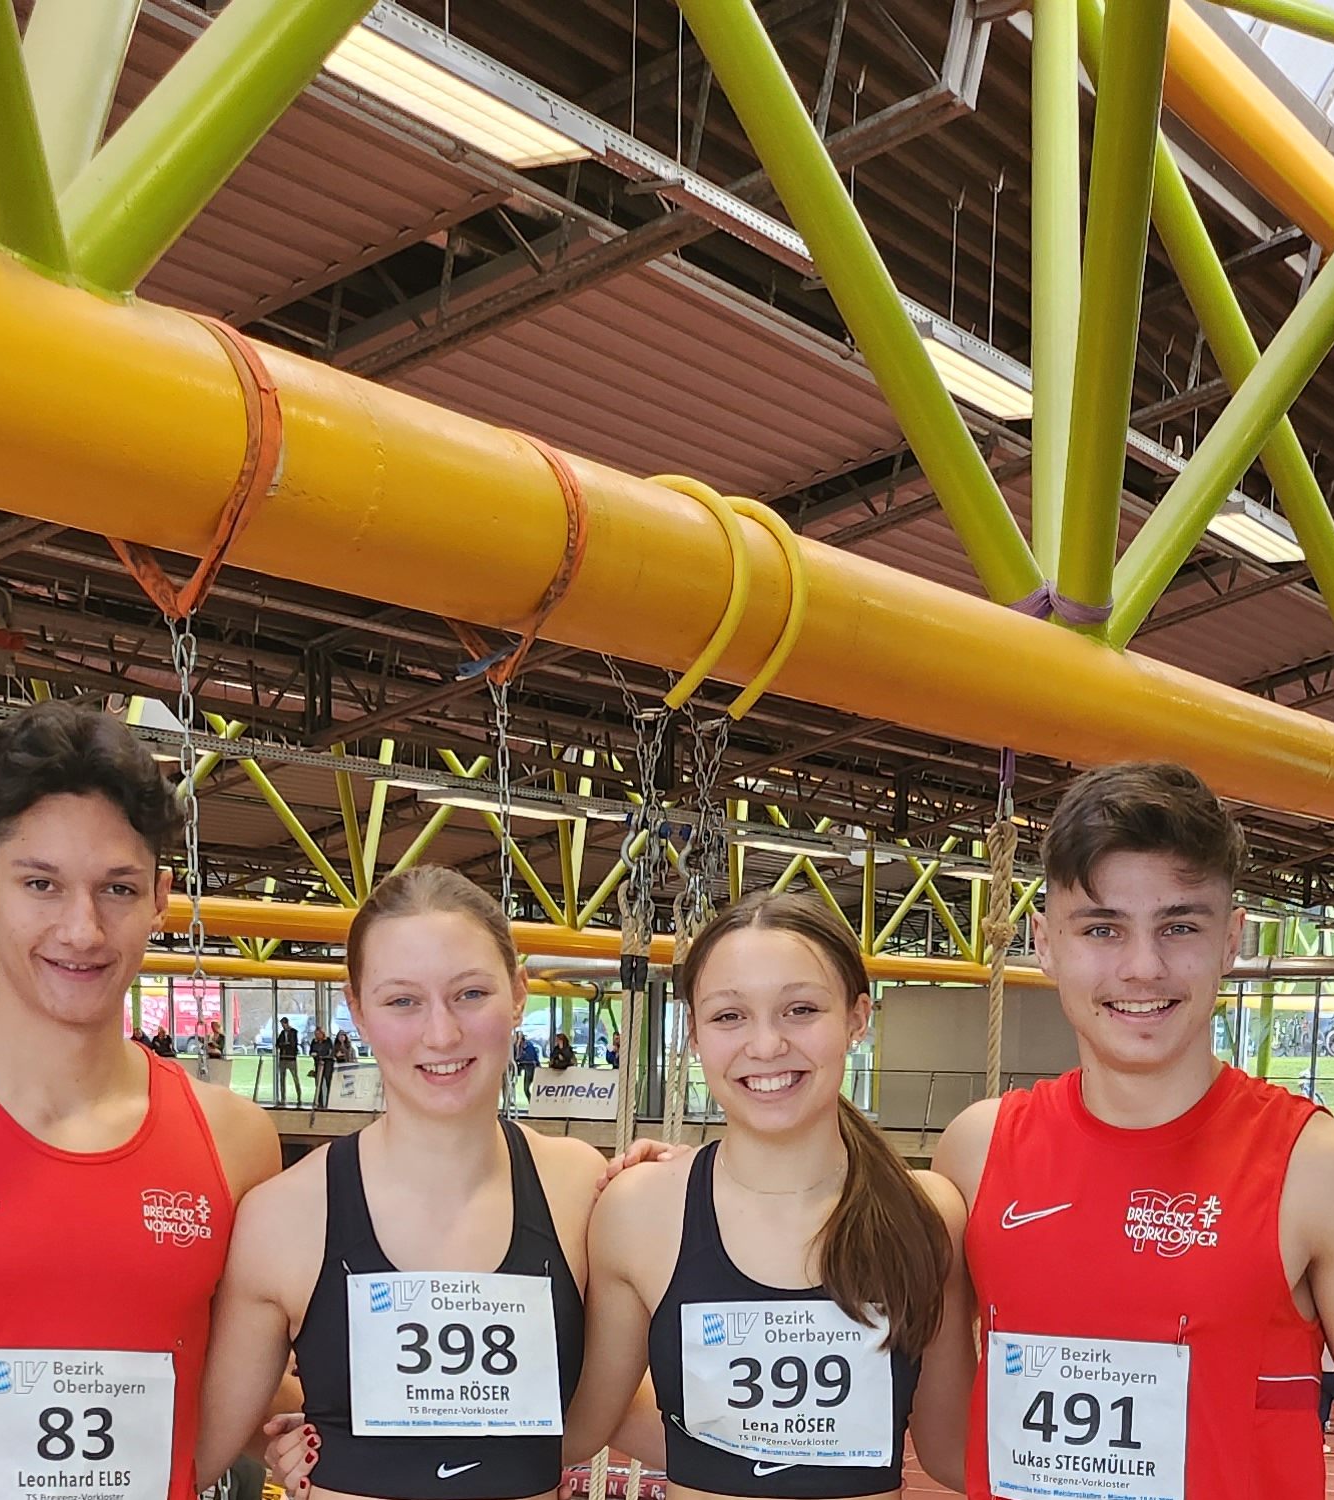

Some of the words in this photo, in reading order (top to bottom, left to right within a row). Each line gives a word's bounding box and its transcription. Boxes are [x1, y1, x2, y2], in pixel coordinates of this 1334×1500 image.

[536, 1082, 616, 1099] vennekel
[143, 1204, 195, 1222] BREGENZ
[1126, 1205, 1196, 1227] BREGENZ
[143, 1218, 212, 1239] VORKLOSTER
[1124, 1222, 1218, 1247] VORKLOSTER
[370, 1279, 426, 1313] BLV
[430, 1279, 481, 1294] Bezirk
[430, 1296, 526, 1316] Oberbayern
[702, 1311, 760, 1346] BLV
[764, 1310, 815, 1326] Bezirk
[764, 1328, 862, 1347] Oberbayern
[395, 1322, 518, 1375] 398
[1060, 1347, 1112, 1364] Bezirk
[53, 1361, 105, 1377] Bezirk
[1005, 1343, 1057, 1378] BLV
[727, 1354, 853, 1410] 399
[1060, 1365, 1158, 1386] Oberbayern
[52, 1378, 146, 1398] Oberbayern
[405, 1384, 455, 1401] Emma
[459, 1380, 511, 1402] RÖSER
[408, 1406, 420, 1415] TS
[422, 1405, 509, 1417] Bregenz-Vorkloster
[1022, 1390, 1142, 1450] 491
[37, 1406, 116, 1462] 83
[742, 1417, 779, 1434] Lena
[783, 1413, 836, 1434] RÖSER
[1012, 1449, 1051, 1469] Lukas
[1055, 1453, 1156, 1478] STEGMÜLLER
[18, 1470, 94, 1488] Leonhard
[99, 1470, 131, 1487] ELBS
[1031, 1473, 1042, 1482] TS
[1043, 1474, 1130, 1490] Bregenz-Vorkloster
